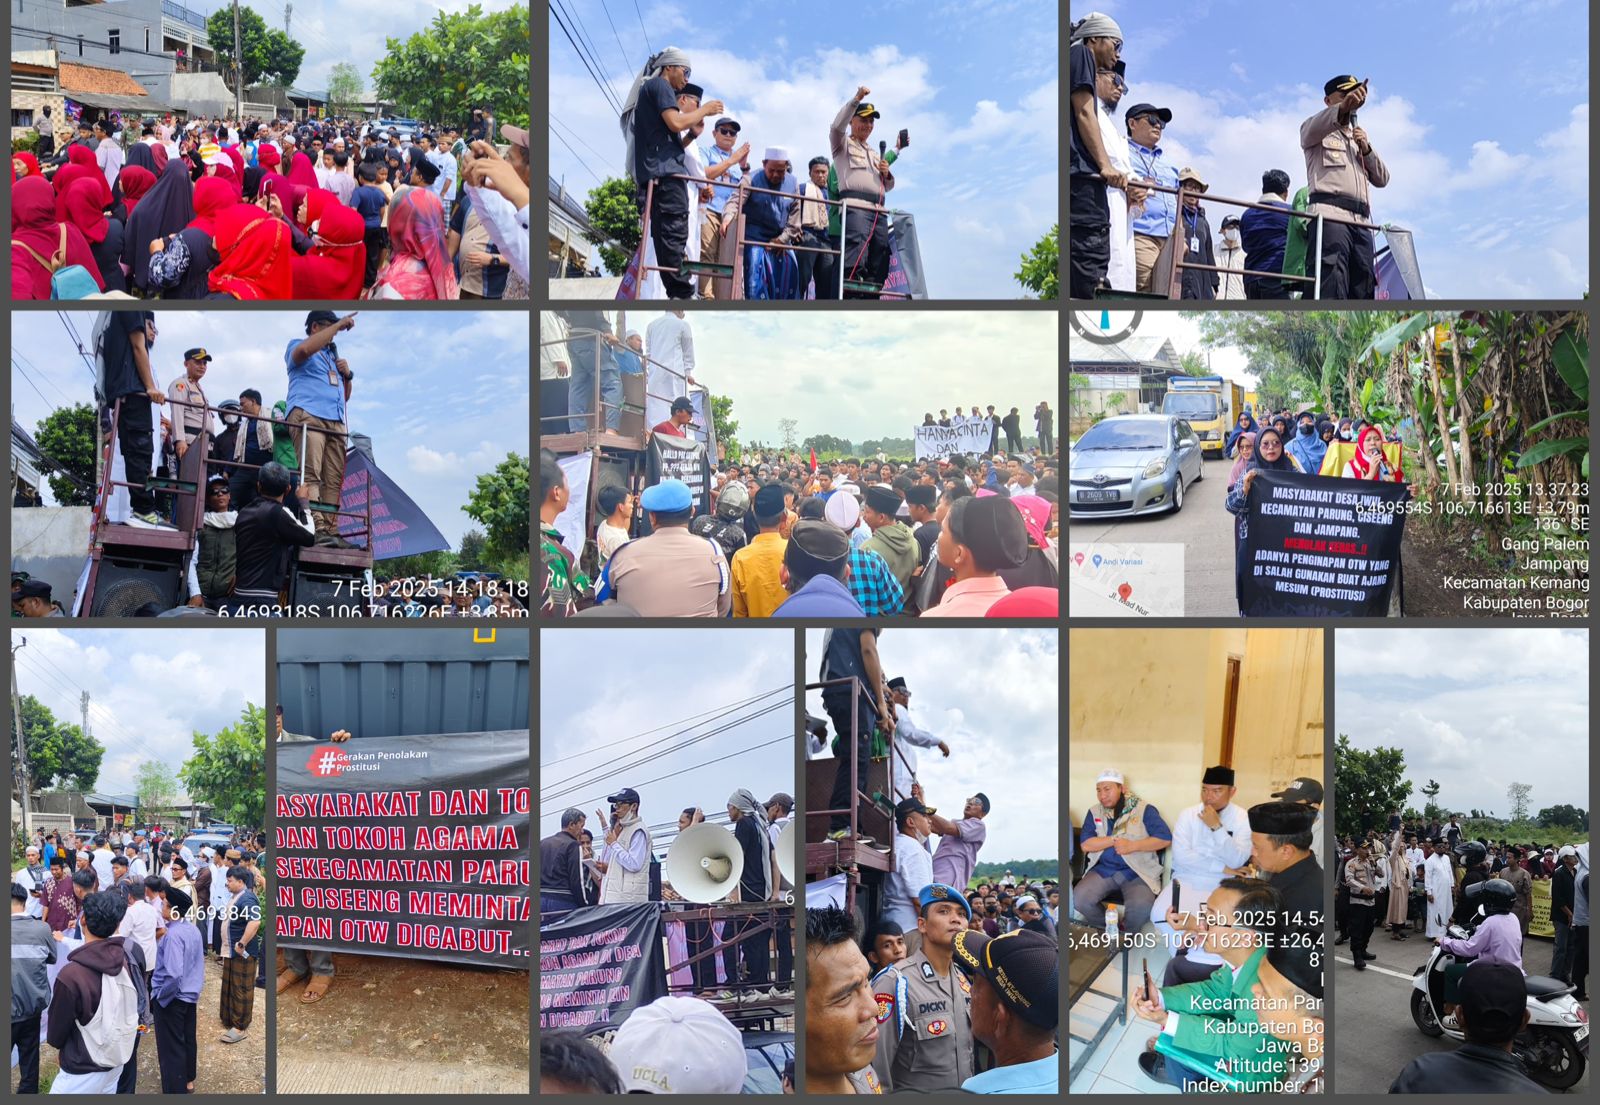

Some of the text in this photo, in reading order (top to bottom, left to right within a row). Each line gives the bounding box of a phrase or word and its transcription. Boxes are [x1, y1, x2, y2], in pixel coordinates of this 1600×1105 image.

[937, 442, 958, 454] DAN
[1273, 487, 1333, 504] MASYARAKAT
[1335, 492, 1358, 505] DESA
[1261, 503, 1315, 518] KECAMATAN
[1318, 509, 1355, 523] PARUNG,
[1294, 522, 1360, 538] DAN JAMPANG.
[1255, 550, 1389, 572] ADANYA PENGINAPAN OTW YANG
[1254, 565, 1387, 587] DI SALAH GUNAKAN BUAT AJANG
[1275, 581, 1308, 595] MESUM
[336, 750, 428, 762] Gerakan Penolakan
[336, 762, 380, 772] Prostitusi
[429, 788, 488, 816] DAN
[323, 826, 405, 851] TOKOH
[415, 824, 519, 851] AGAMA
[276, 856, 452, 883] SEKECAMATAN
[301, 887, 400, 913] CISEENG
[276, 915, 333, 940] APAN
[340, 918, 389, 944] OTW
[553, 989, 606, 1007] MEMINTA
[919, 1001, 946, 1014] DICKY
[632, 1067, 669, 1090] UCLA
